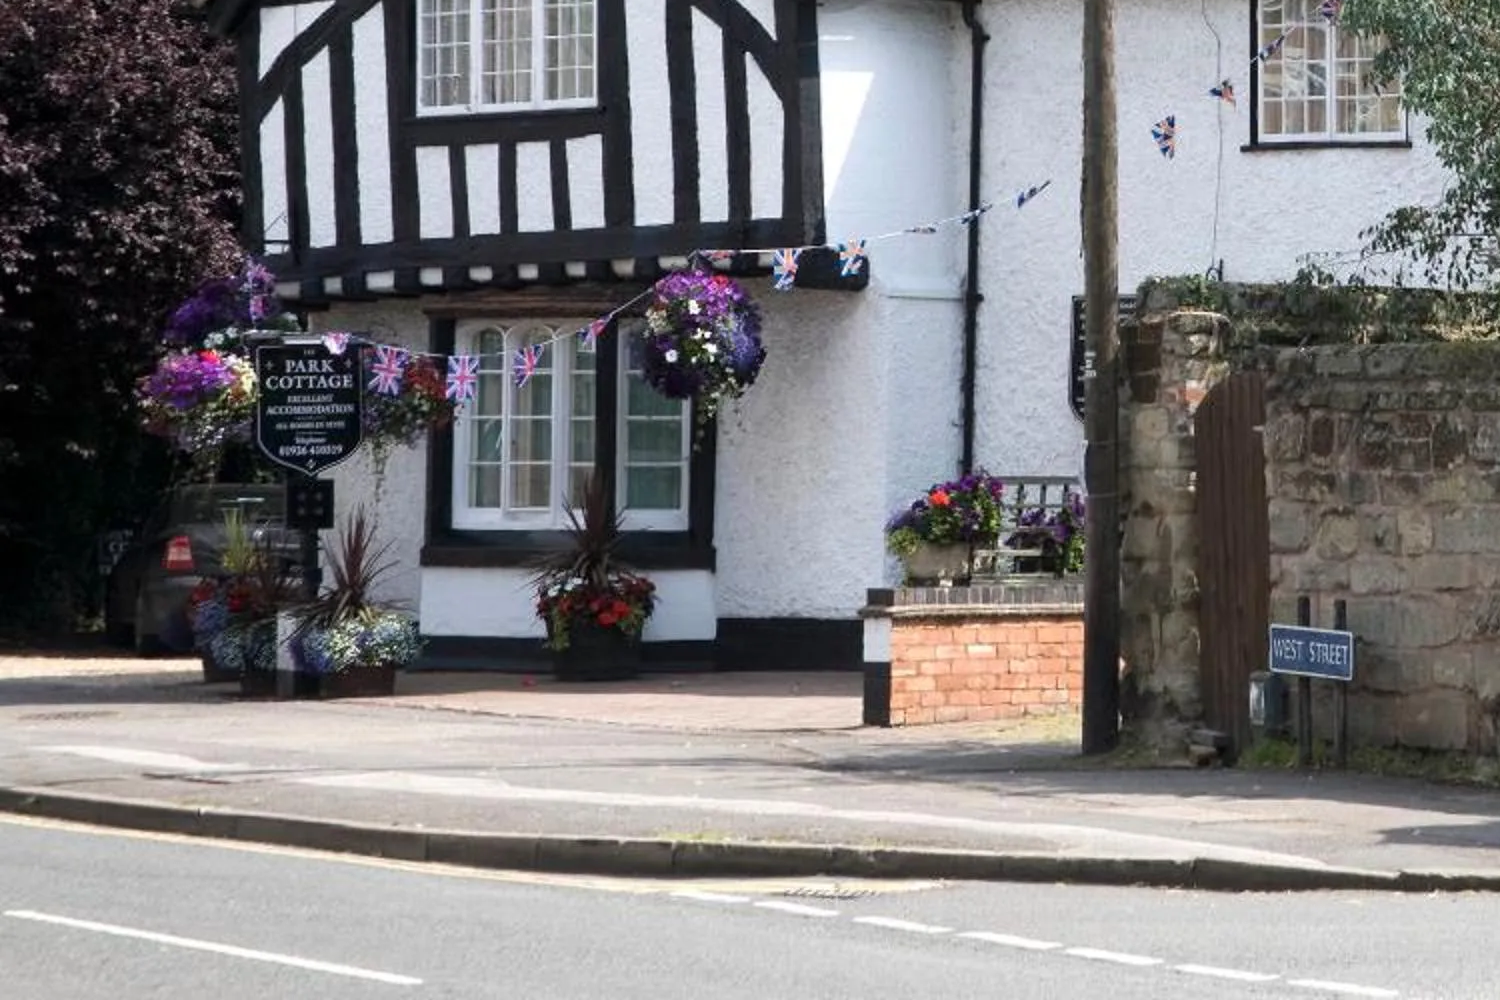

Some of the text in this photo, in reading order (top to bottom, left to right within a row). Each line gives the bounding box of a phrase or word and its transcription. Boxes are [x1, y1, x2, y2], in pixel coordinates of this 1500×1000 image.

[285, 359, 335, 373] PARK
[265, 375, 353, 390] COTTAGE
[1273, 639, 1348, 665] WEST STREET
